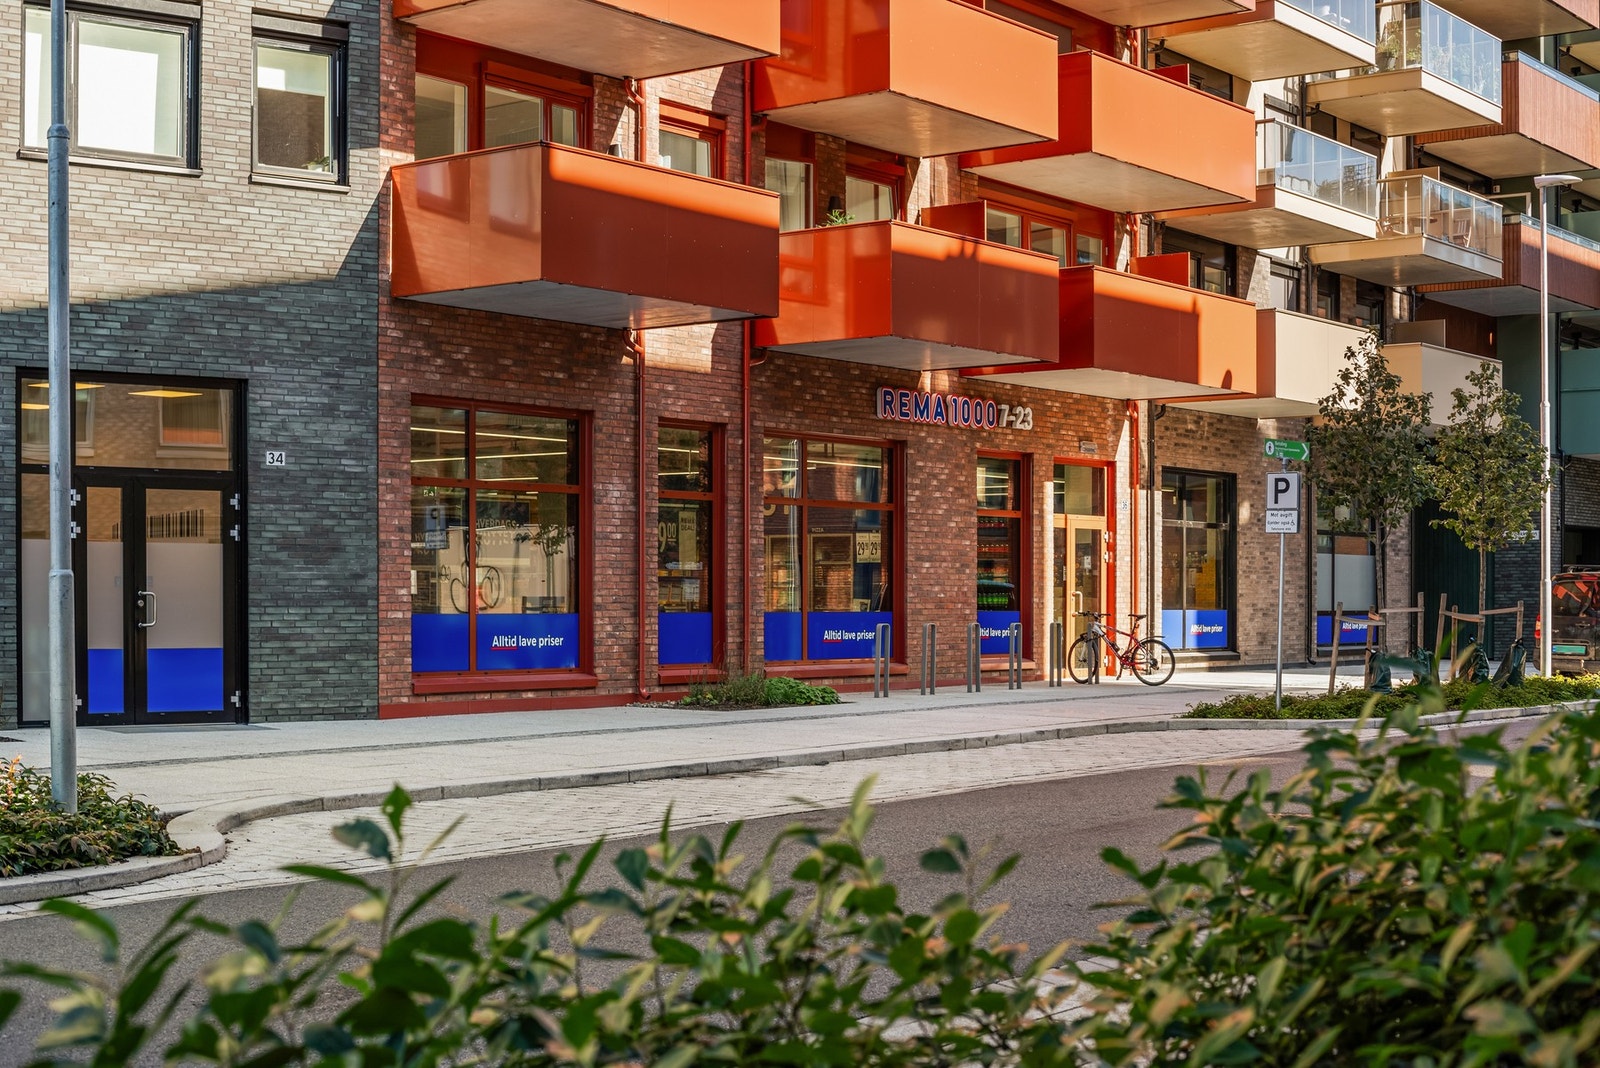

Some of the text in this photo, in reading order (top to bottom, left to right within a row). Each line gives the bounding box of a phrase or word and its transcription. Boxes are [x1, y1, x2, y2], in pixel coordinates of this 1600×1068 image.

[878, 387, 998, 429] REMA 1000
[998, 404, 1033, 430] 7-23
[268, 452, 284, 464] 34
[1273, 477, 1290, 504] P
[823, 629, 875, 641] Alltid lave priser
[990, 627, 1001, 637] lave
[492, 634, 564, 648] Alltid lave priser
